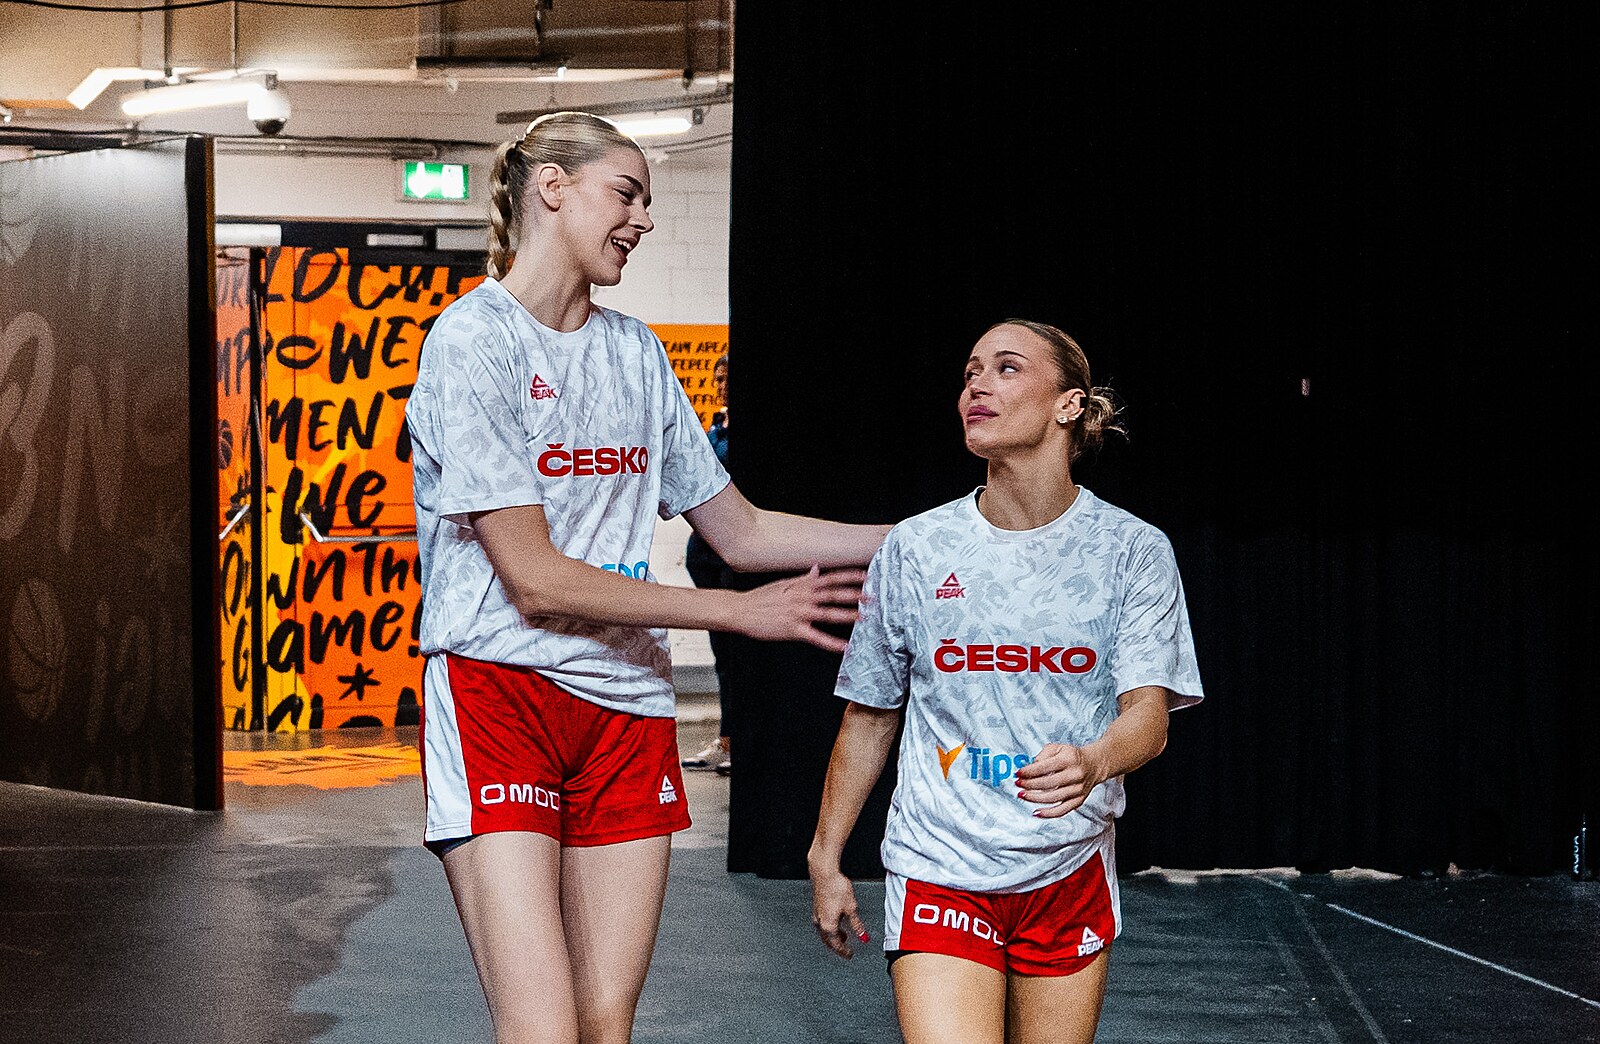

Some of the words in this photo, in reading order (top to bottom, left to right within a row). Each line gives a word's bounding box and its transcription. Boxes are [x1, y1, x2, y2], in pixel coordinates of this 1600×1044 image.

[530, 387, 558, 400] PEAK
[537, 443, 648, 477] ČESKO
[936, 587, 965, 600] PEAK
[934, 638, 1097, 674] ČESKO
[1077, 938, 1105, 957] PEAK
